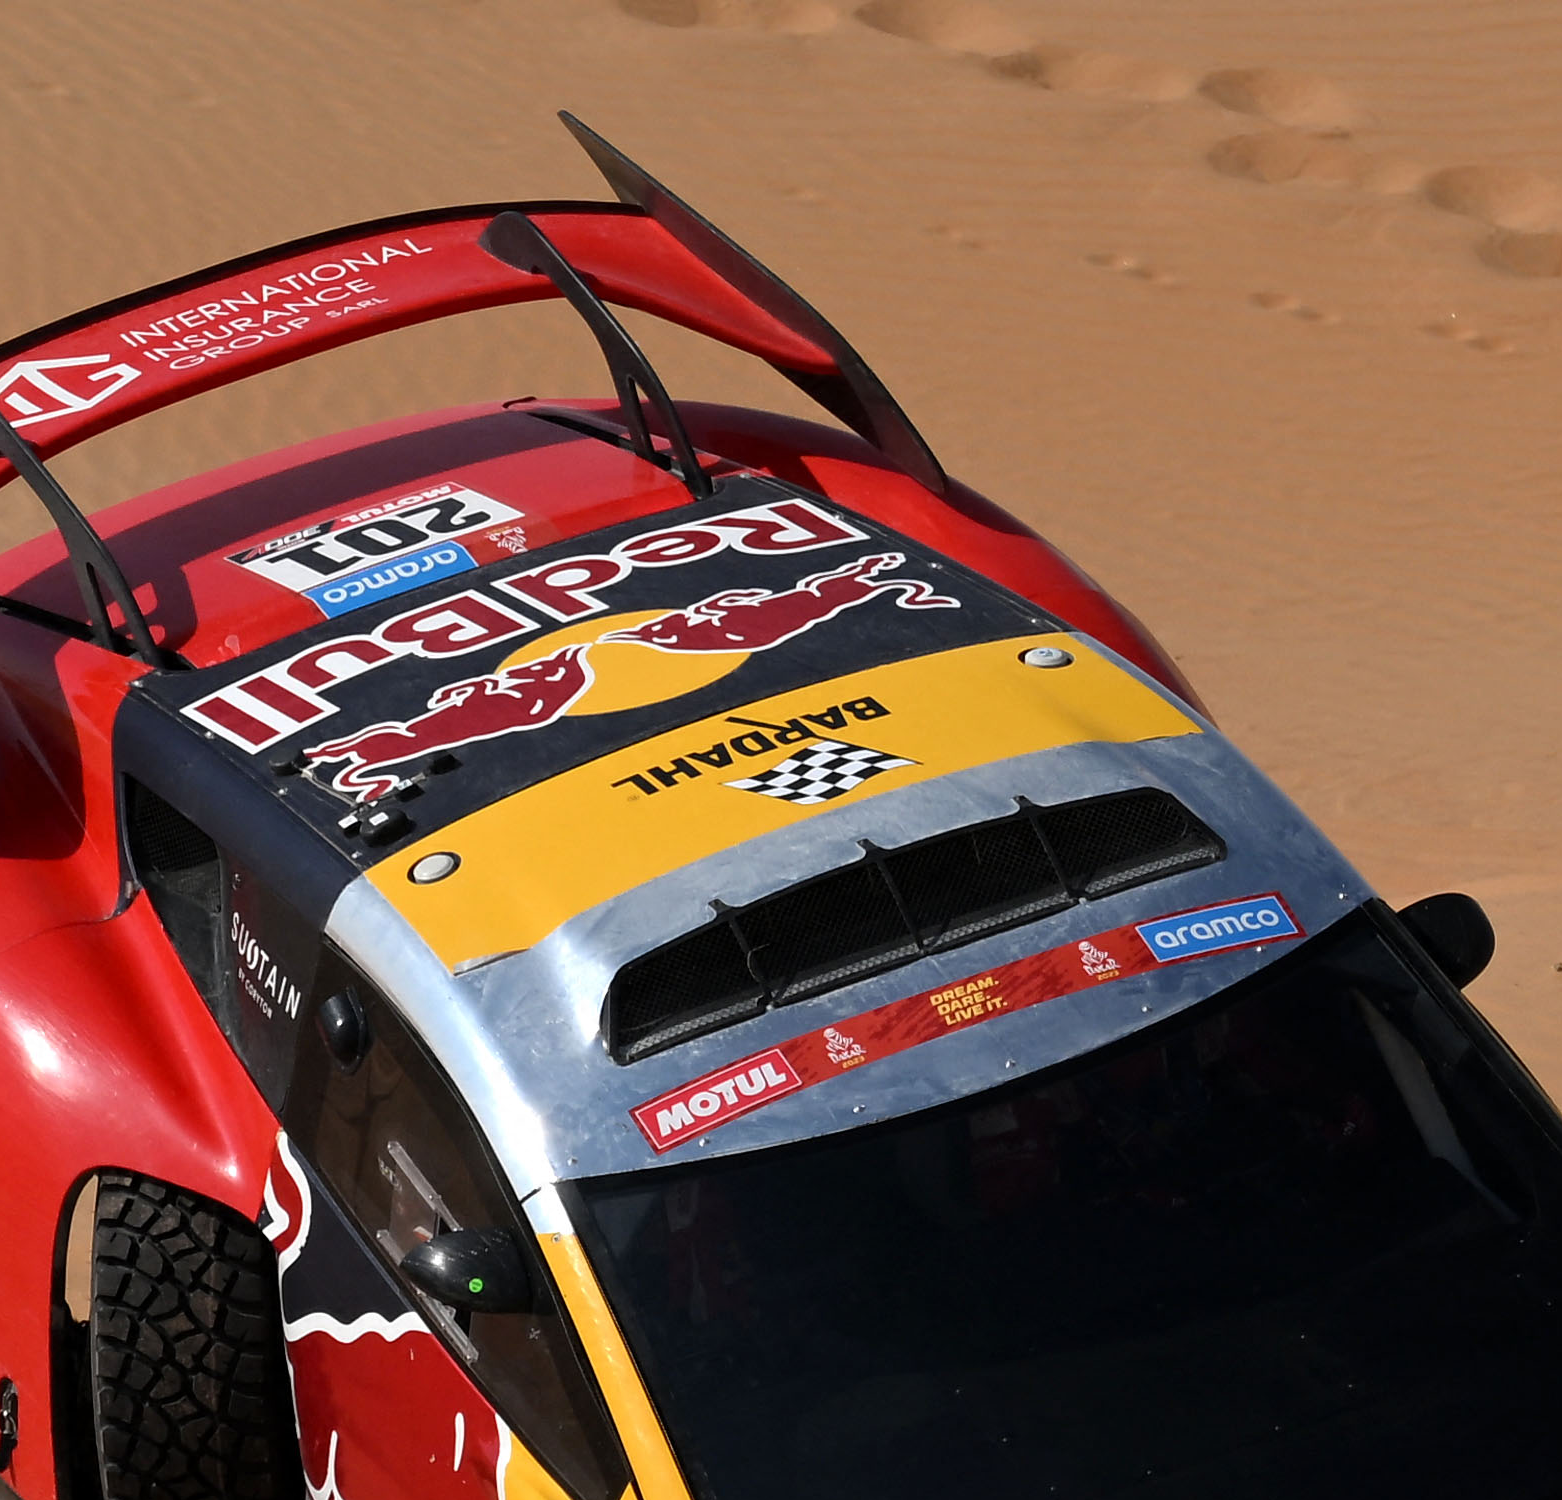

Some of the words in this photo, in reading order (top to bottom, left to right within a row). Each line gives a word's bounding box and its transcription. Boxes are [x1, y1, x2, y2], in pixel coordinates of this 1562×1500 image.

[119, 238, 433, 348] INTERNATIONAL
[143, 278, 376, 362] INSURANCE
[169, 316, 311, 371] GROUP
[325, 296, 390, 319] SARL
[265, 497, 491, 576] 201
[340, 485, 452, 523] MOTUL
[323, 548, 458, 603] aramco
[611, 696, 892, 795] BARDAHL
[1154, 908, 1280, 949] aramco
[930, 977, 999, 1006] DREAM.
[937, 992, 991, 1016] DARE.
[945, 1004, 984, 1026] LIVE
[986, 997, 1008, 1011] IT.
[654, 1061, 787, 1138] MOTUL
